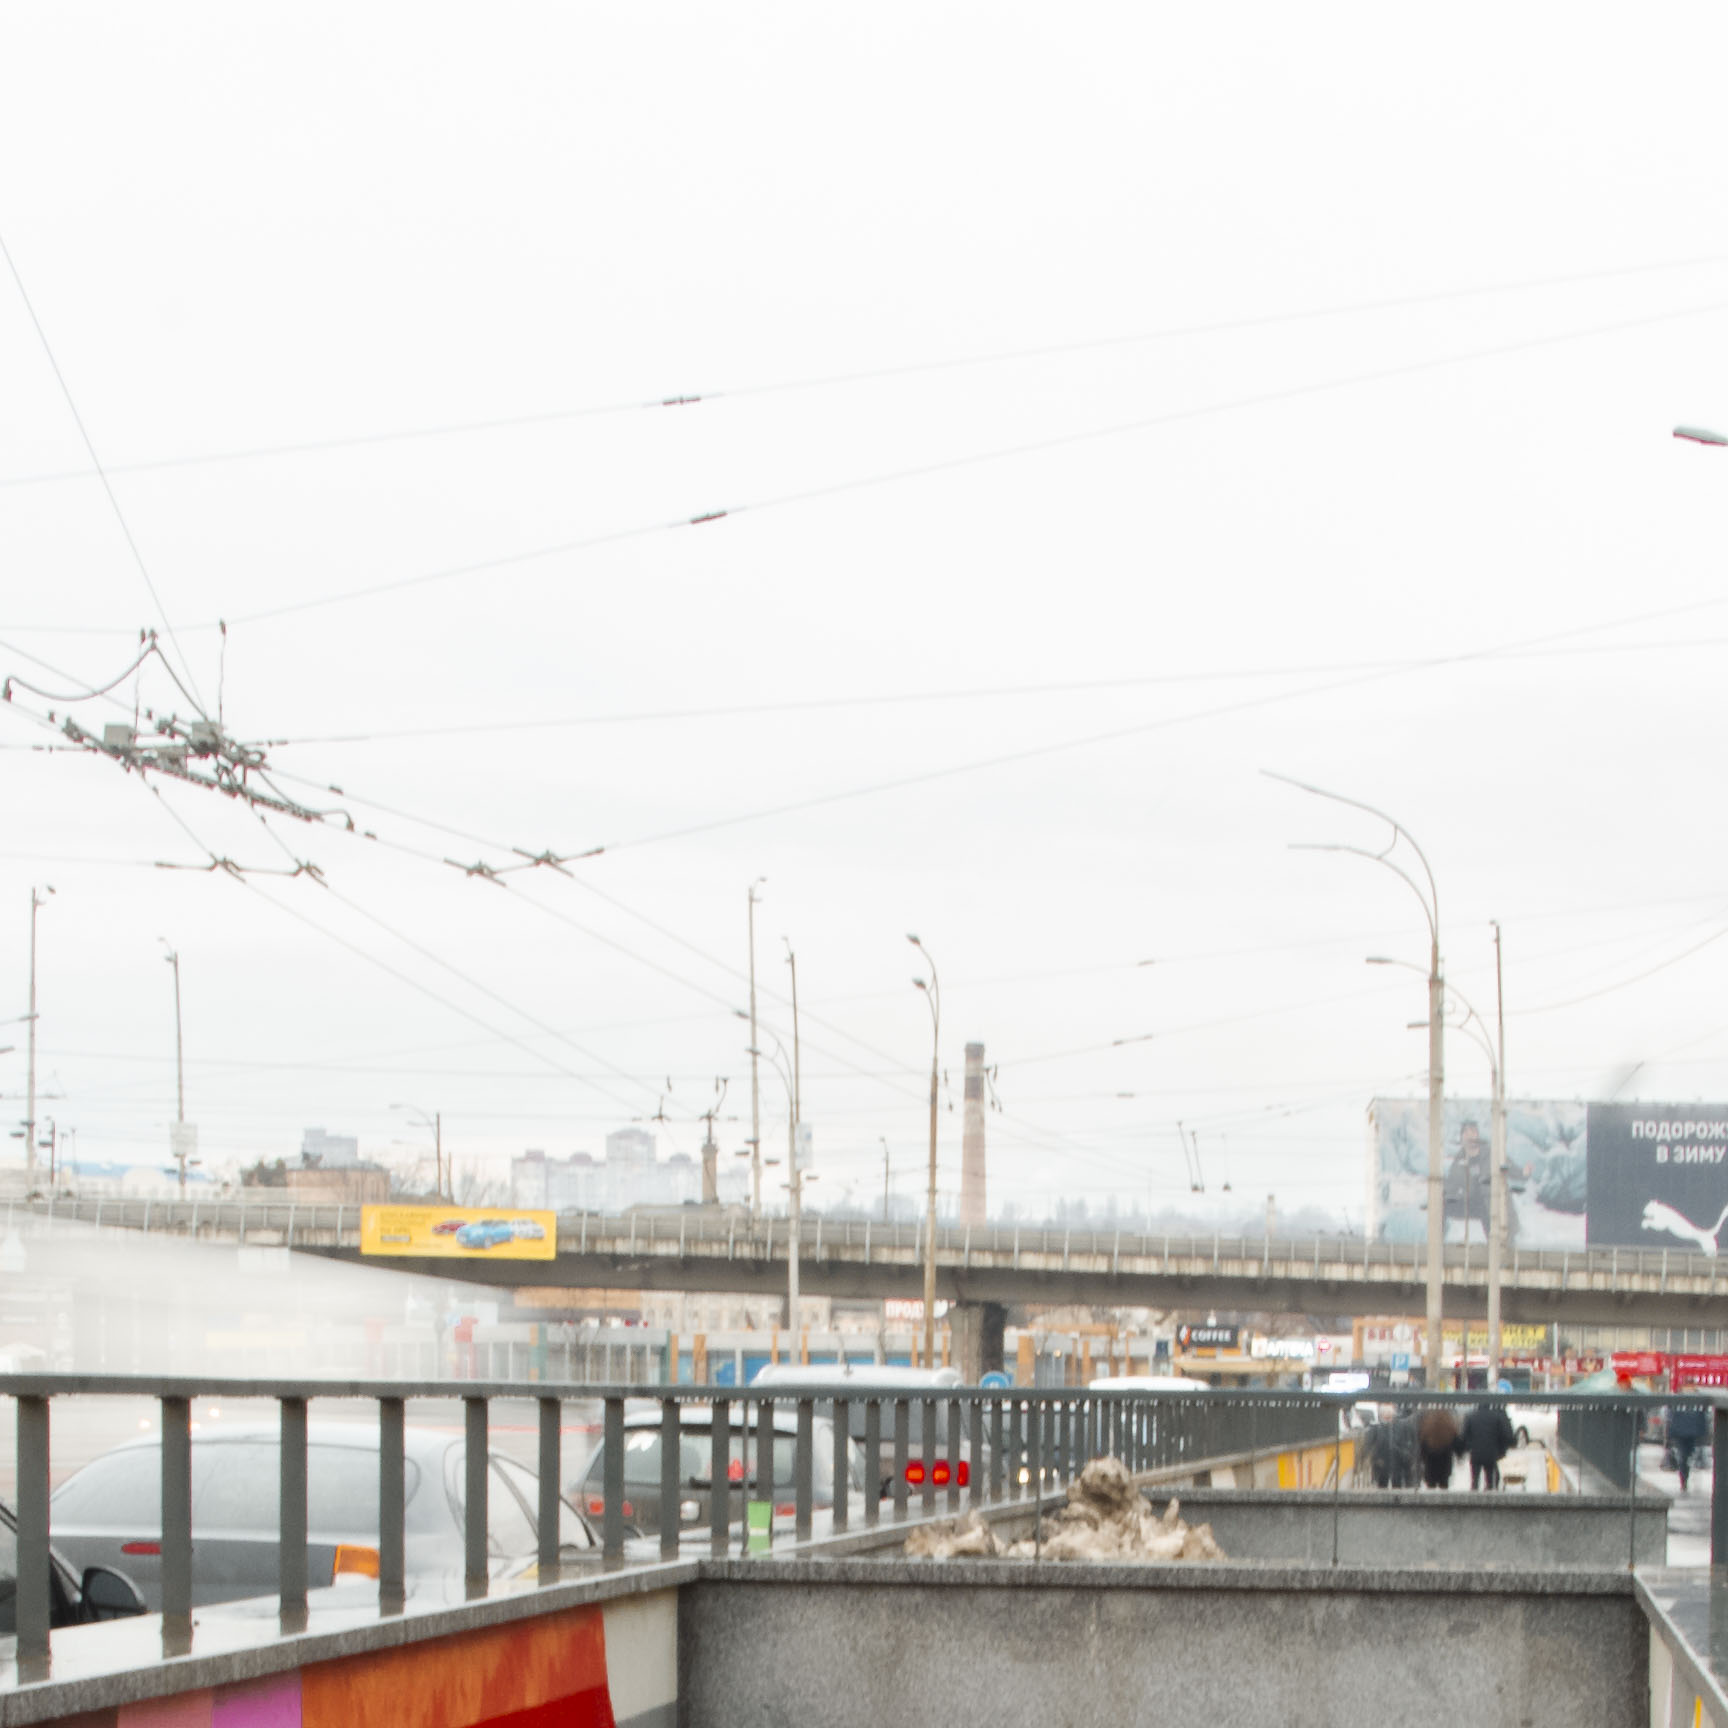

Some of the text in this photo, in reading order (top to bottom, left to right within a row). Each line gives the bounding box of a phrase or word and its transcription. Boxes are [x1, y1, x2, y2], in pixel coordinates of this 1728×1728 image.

[1656, 1145, 1727, 1163] В ЗИМУ
[1191, 1330, 1232, 1342] COFFEE
